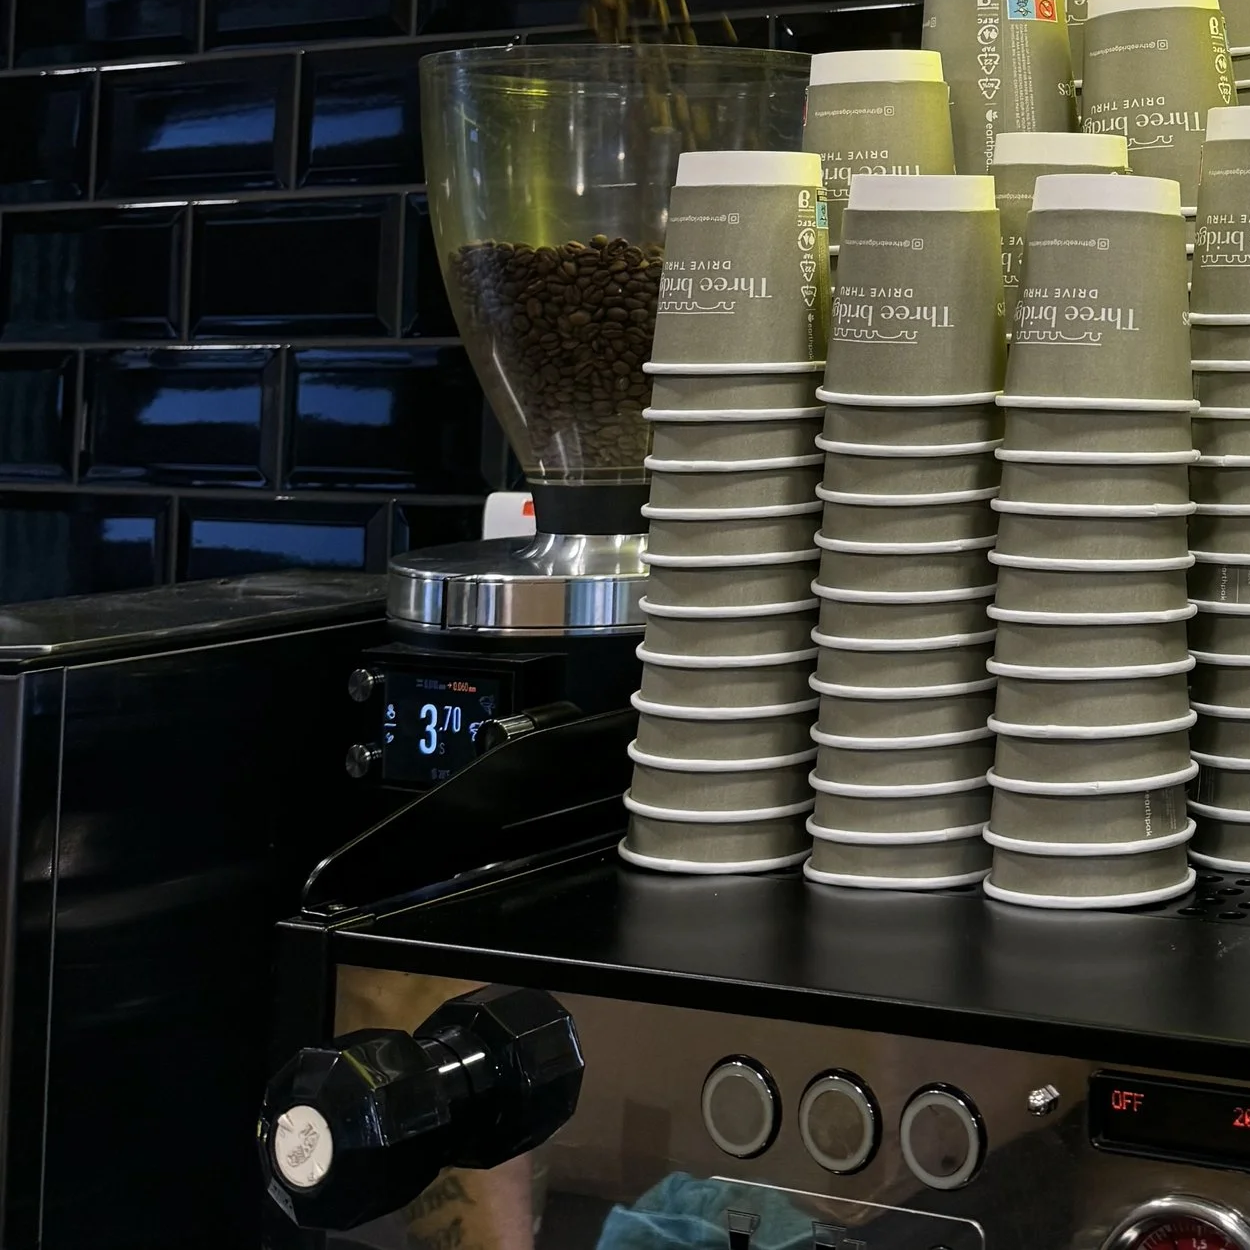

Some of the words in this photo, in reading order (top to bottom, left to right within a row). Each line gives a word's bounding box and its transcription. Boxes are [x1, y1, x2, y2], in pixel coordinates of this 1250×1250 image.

[1091, 101, 1118, 114] THRU
[1123, 96, 1165, 109] DRIVE
[1135, 111, 1205, 132] Three
[984, 123, 995, 171] earthpa
[820, 152, 842, 160] THR
[847, 150, 888, 160] DRIVE
[1206, 214, 1235, 224] THRU
[665, 261, 686, 270] THRU
[690, 260, 731, 271] DRIVE
[700, 277, 773, 299] Three
[840, 286, 865, 297] THRU
[870, 288, 913, 297] DRIVE
[1023, 288, 1049, 298] THRU
[1054, 288, 1098, 299] DRIVE
[880, 305, 954, 327] Three
[1064, 306, 1140, 331] Three
[1220, 566, 1228, 601] arthpak
[1111, 1090, 1144, 1111] OFF
